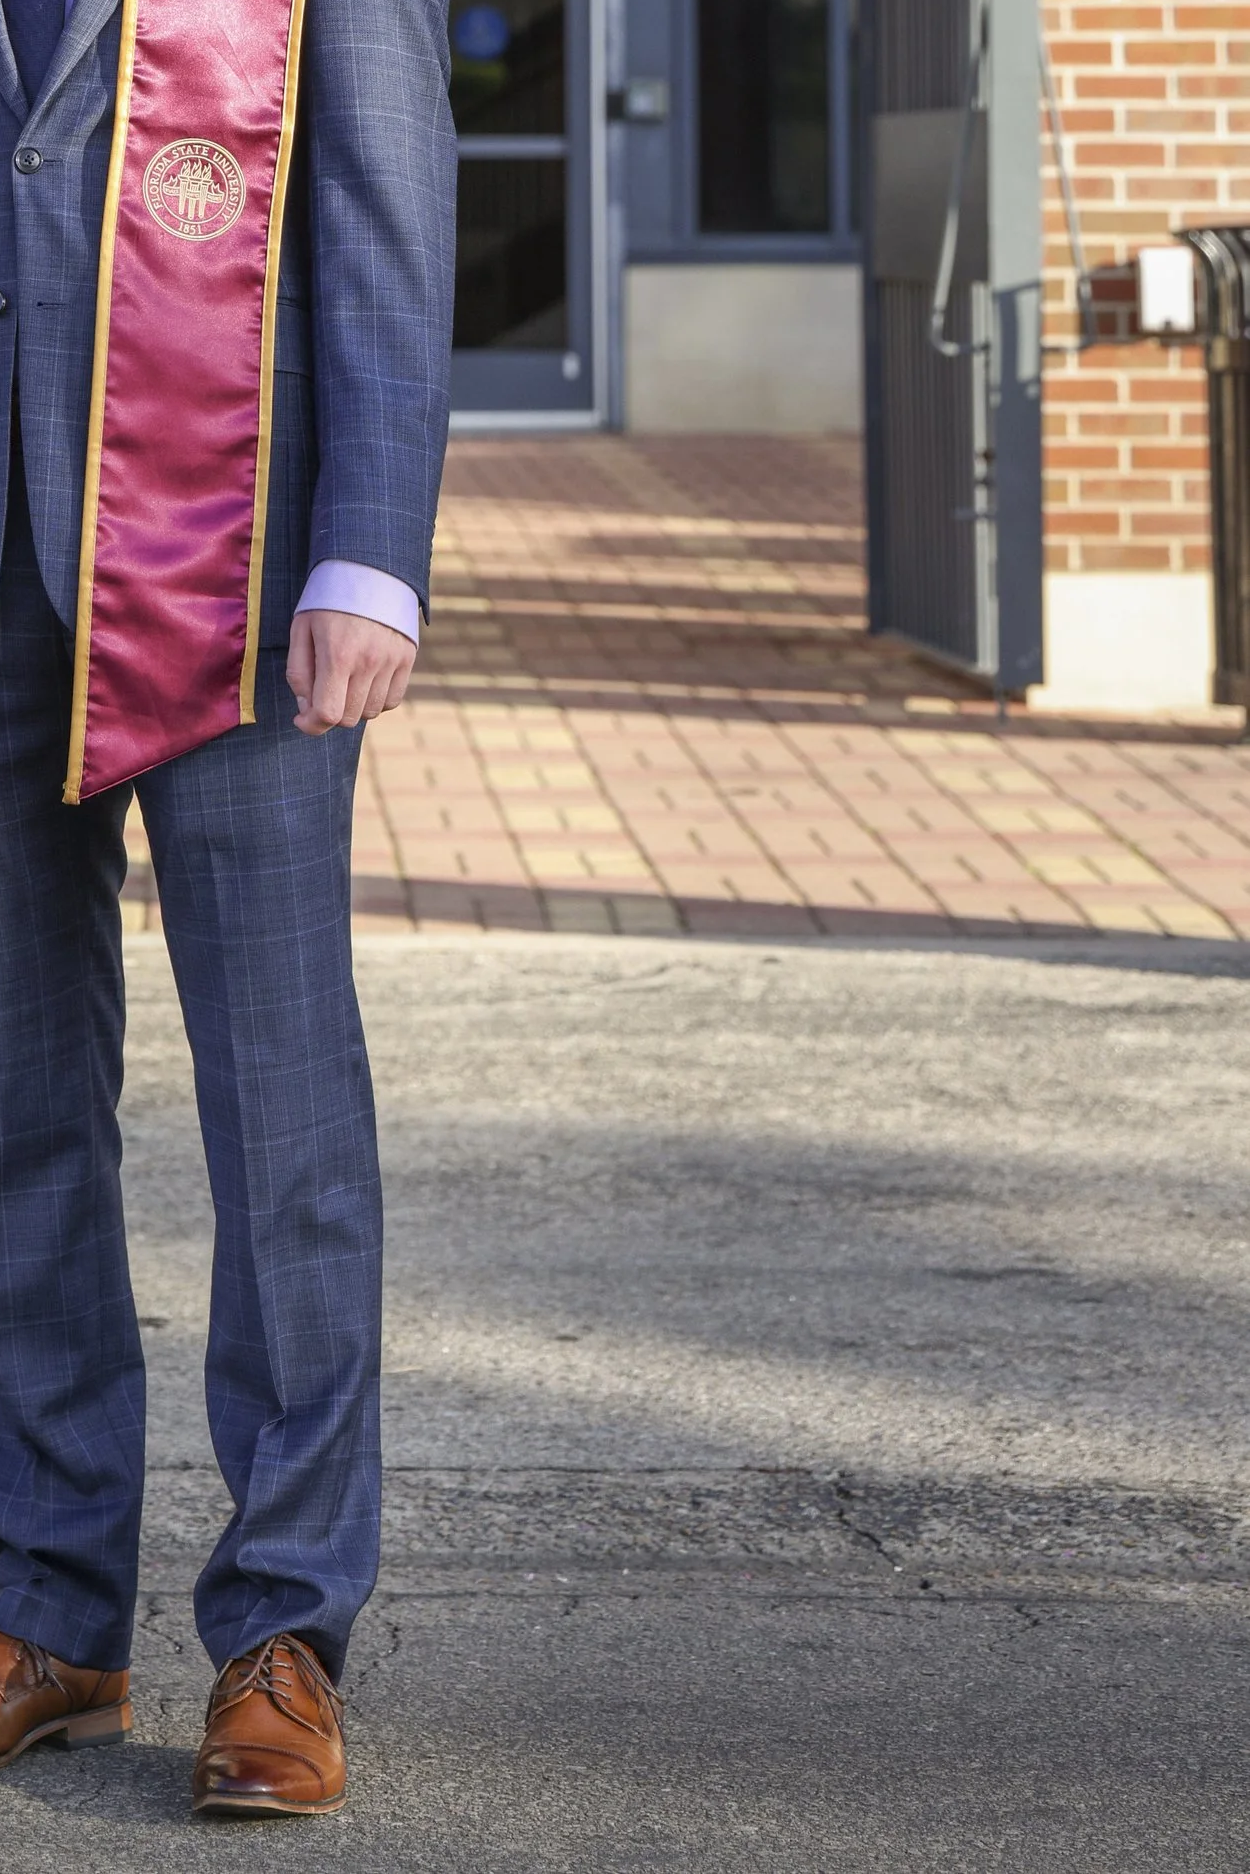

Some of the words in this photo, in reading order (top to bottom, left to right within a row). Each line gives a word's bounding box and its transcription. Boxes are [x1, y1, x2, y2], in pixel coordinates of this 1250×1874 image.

[149, 157, 172, 210] FLORIDA
[172, 145, 210, 158] STATE
[212, 152, 239, 222] UNIVERSITY
[178, 222, 203, 235] 1851
